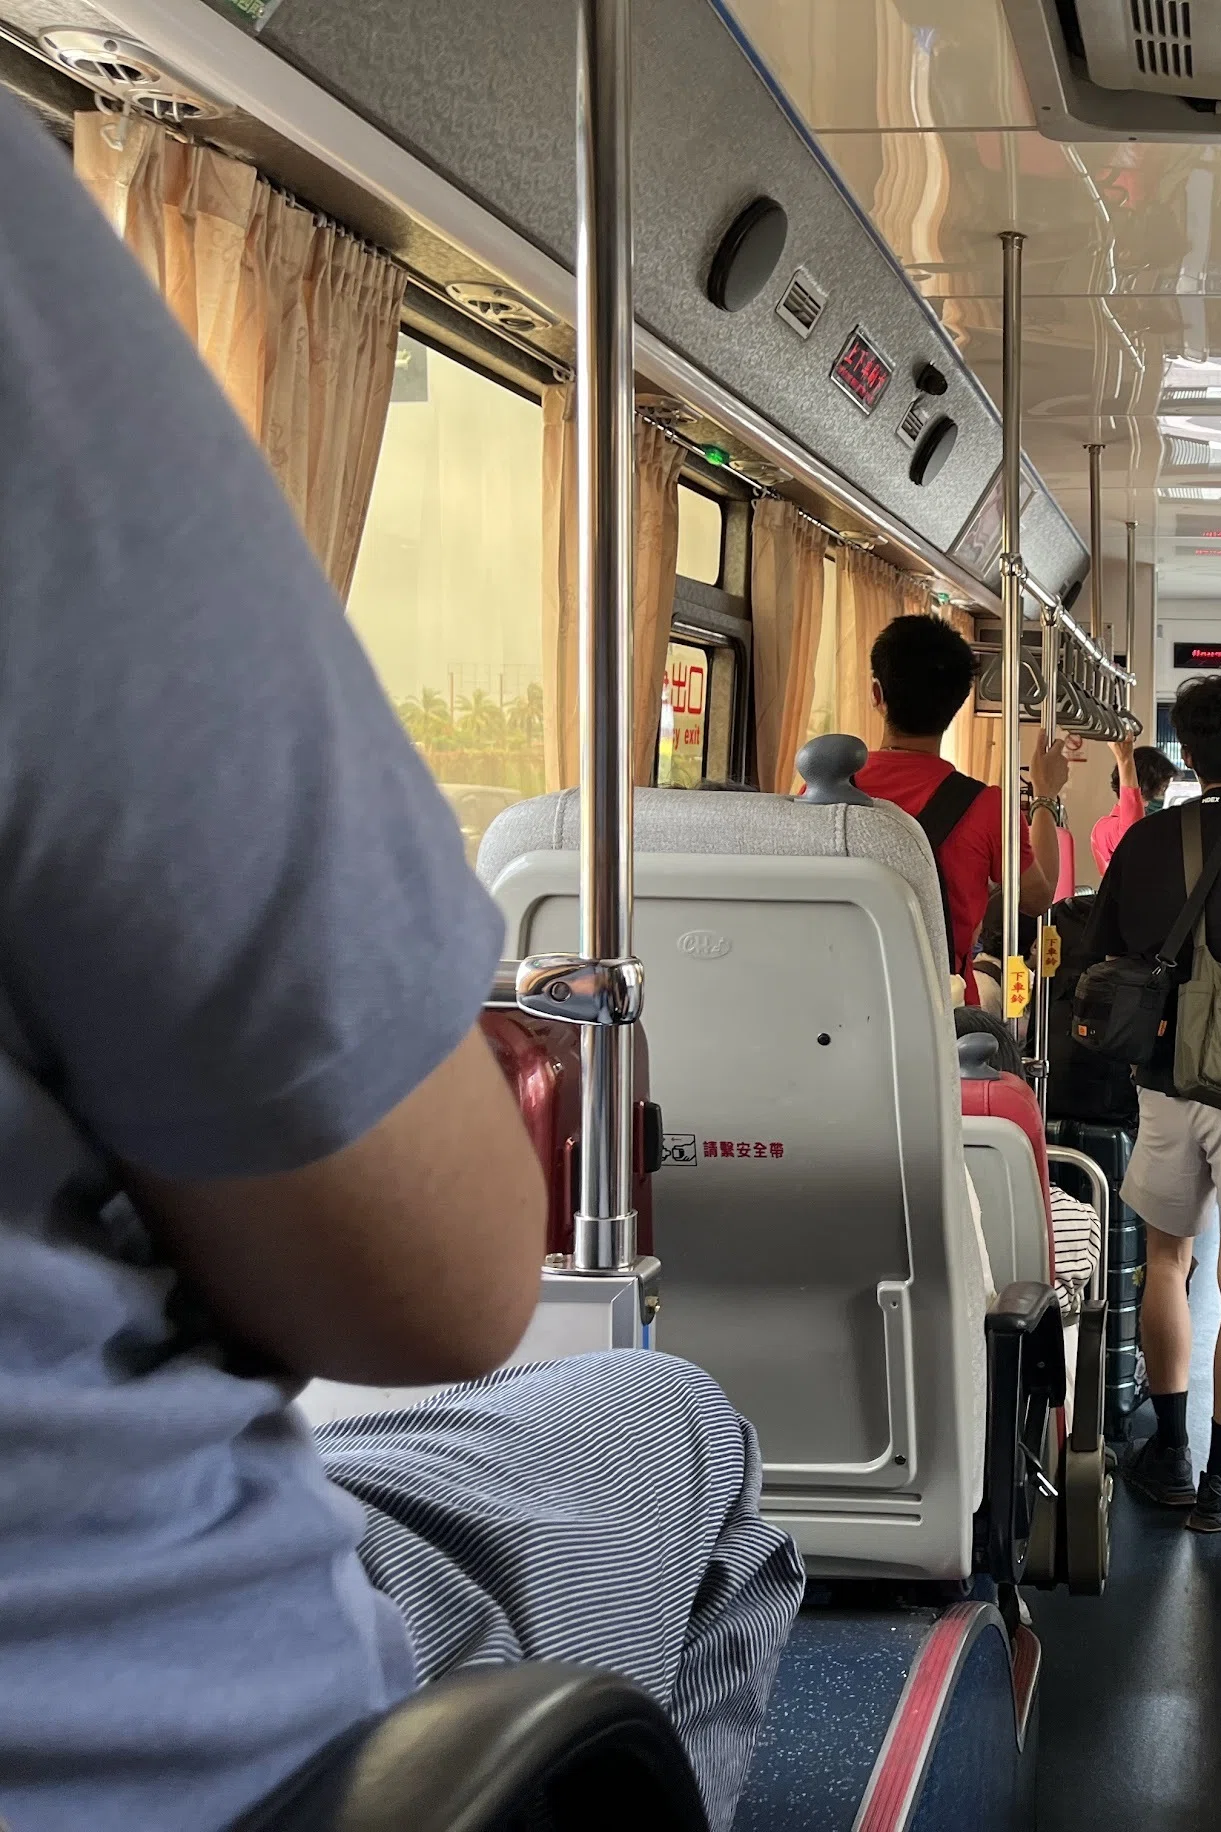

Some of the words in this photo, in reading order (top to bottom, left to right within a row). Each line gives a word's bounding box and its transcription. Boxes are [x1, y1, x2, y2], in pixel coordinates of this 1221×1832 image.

[664, 661, 704, 715] 出口
[685, 723, 701, 745] exit
[1010, 971, 1026, 1004] 下車鈴
[703, 1141, 784, 1159] 請繫安全帶
